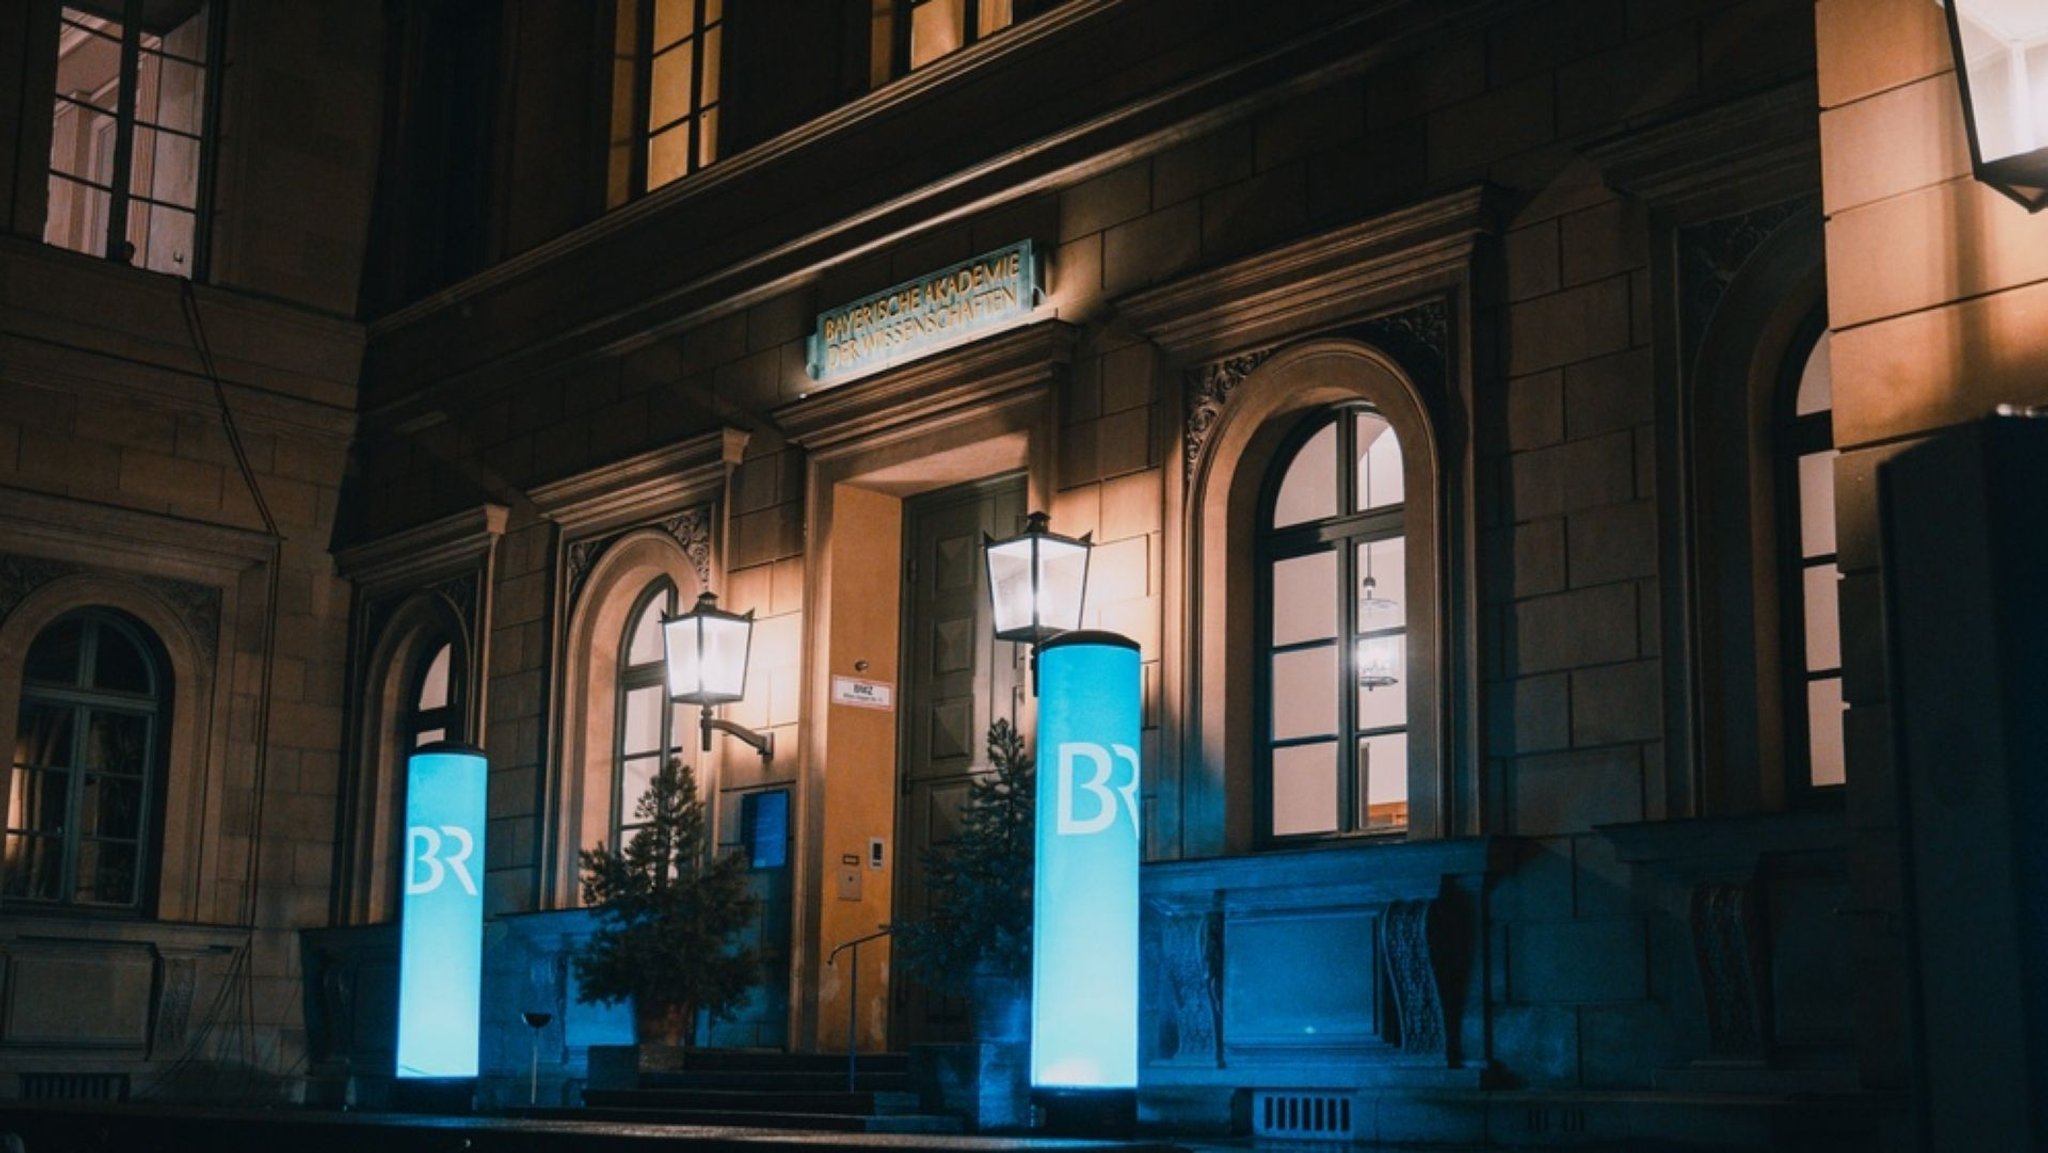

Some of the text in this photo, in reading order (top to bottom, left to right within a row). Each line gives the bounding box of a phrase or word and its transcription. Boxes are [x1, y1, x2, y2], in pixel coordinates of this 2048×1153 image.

[825, 251, 1019, 341] BAYERISCHE AKADEMIE
[827, 283, 1017, 369] DER WISSENSCHAFTEN
[1057, 742, 1140, 840] BR
[406, 825, 478, 896] BR
